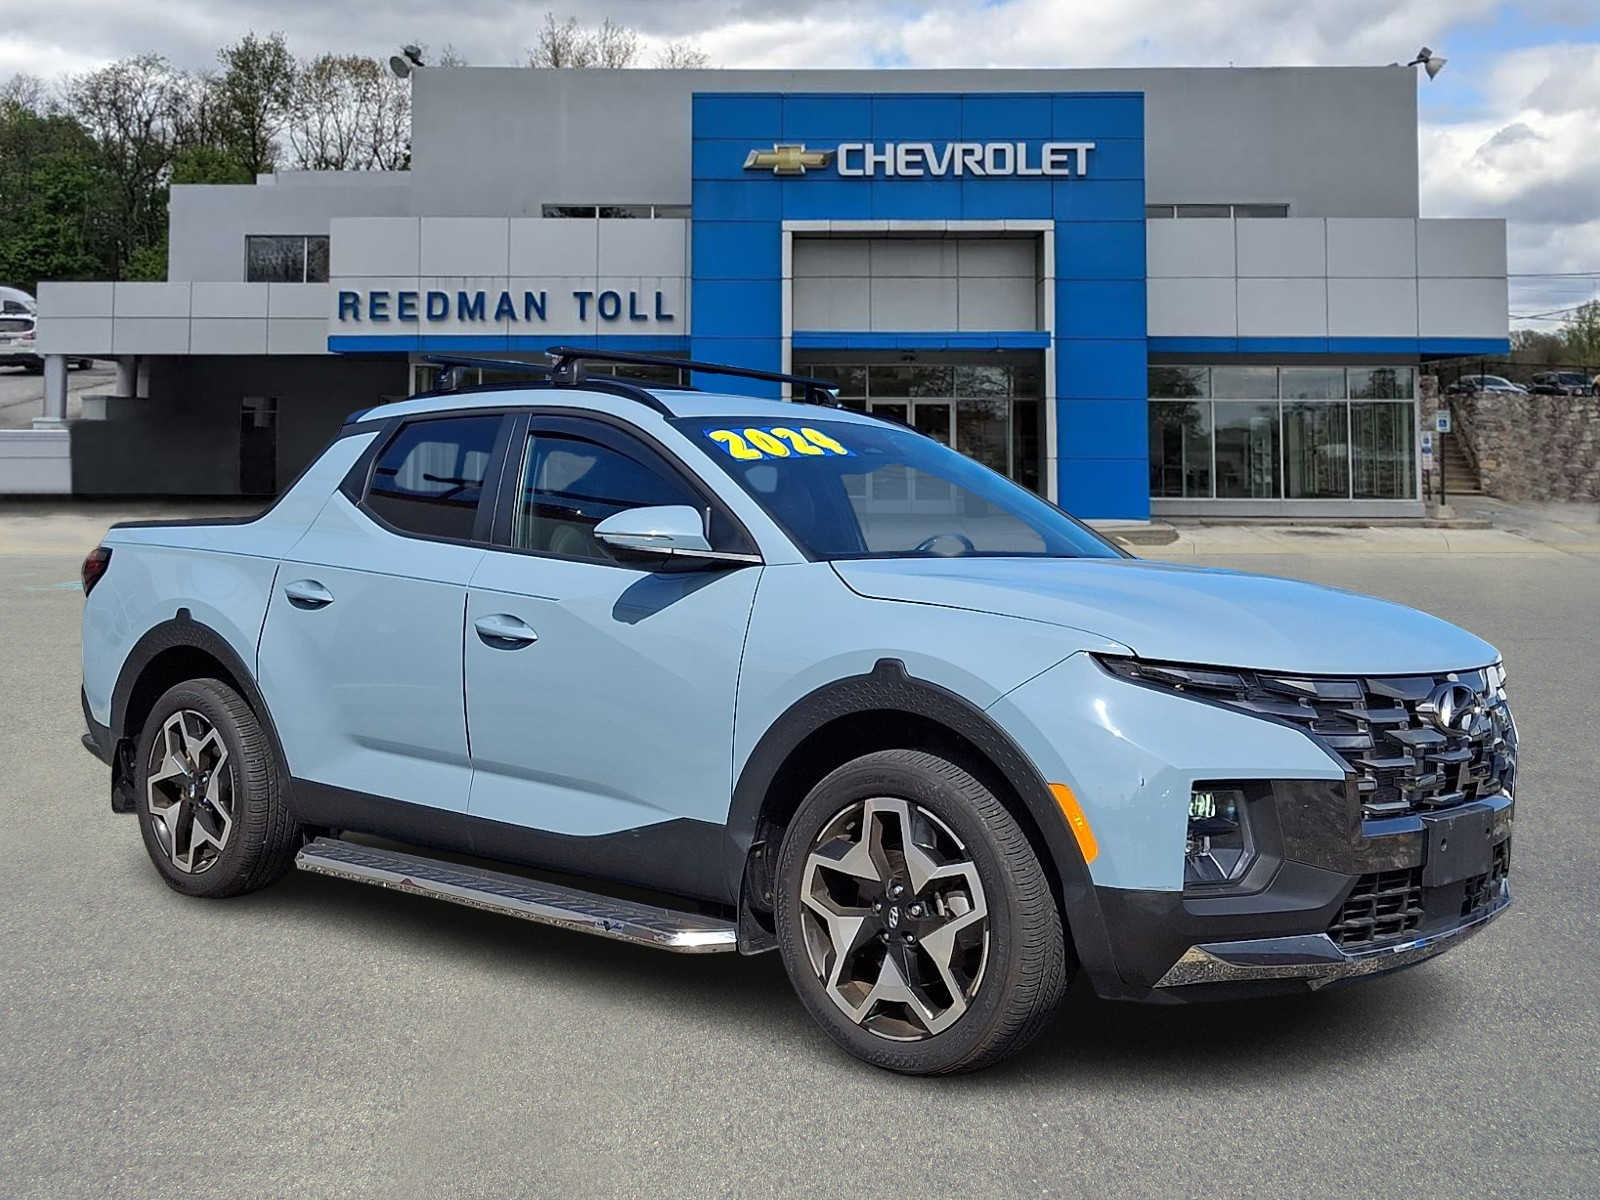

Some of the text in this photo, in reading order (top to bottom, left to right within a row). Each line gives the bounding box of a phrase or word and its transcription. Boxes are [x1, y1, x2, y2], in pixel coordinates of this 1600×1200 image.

[837, 142, 1096, 177] CHEVROLET
[338, 291, 675, 322] REEDMAN TOLL
[708, 427, 848, 460] 2024
